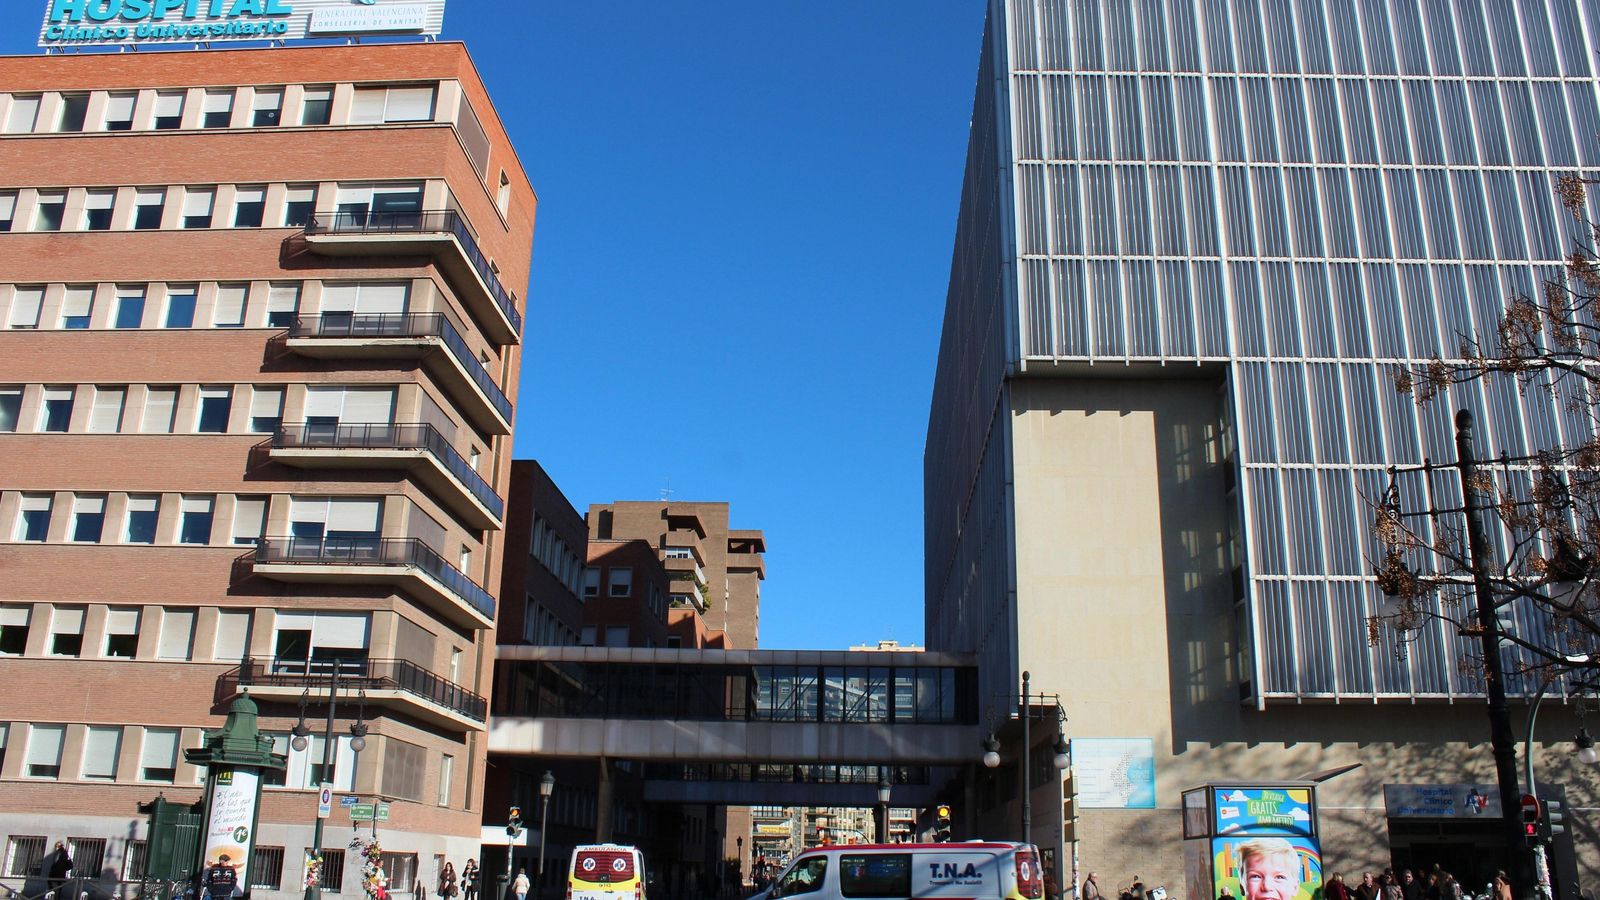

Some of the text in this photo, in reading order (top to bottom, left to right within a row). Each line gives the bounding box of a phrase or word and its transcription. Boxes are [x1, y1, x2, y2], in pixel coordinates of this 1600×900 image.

[51, 0, 292, 20] HOSPITAL
[314, 7, 424, 18] GENERALITAT VALENCIANA
[136, 20, 288, 38] Universitario
[1416, 787, 1453, 796] Hospital
[1250, 801, 1278, 815] GRATIS
[929, 862, 983, 879] T.N.A.
